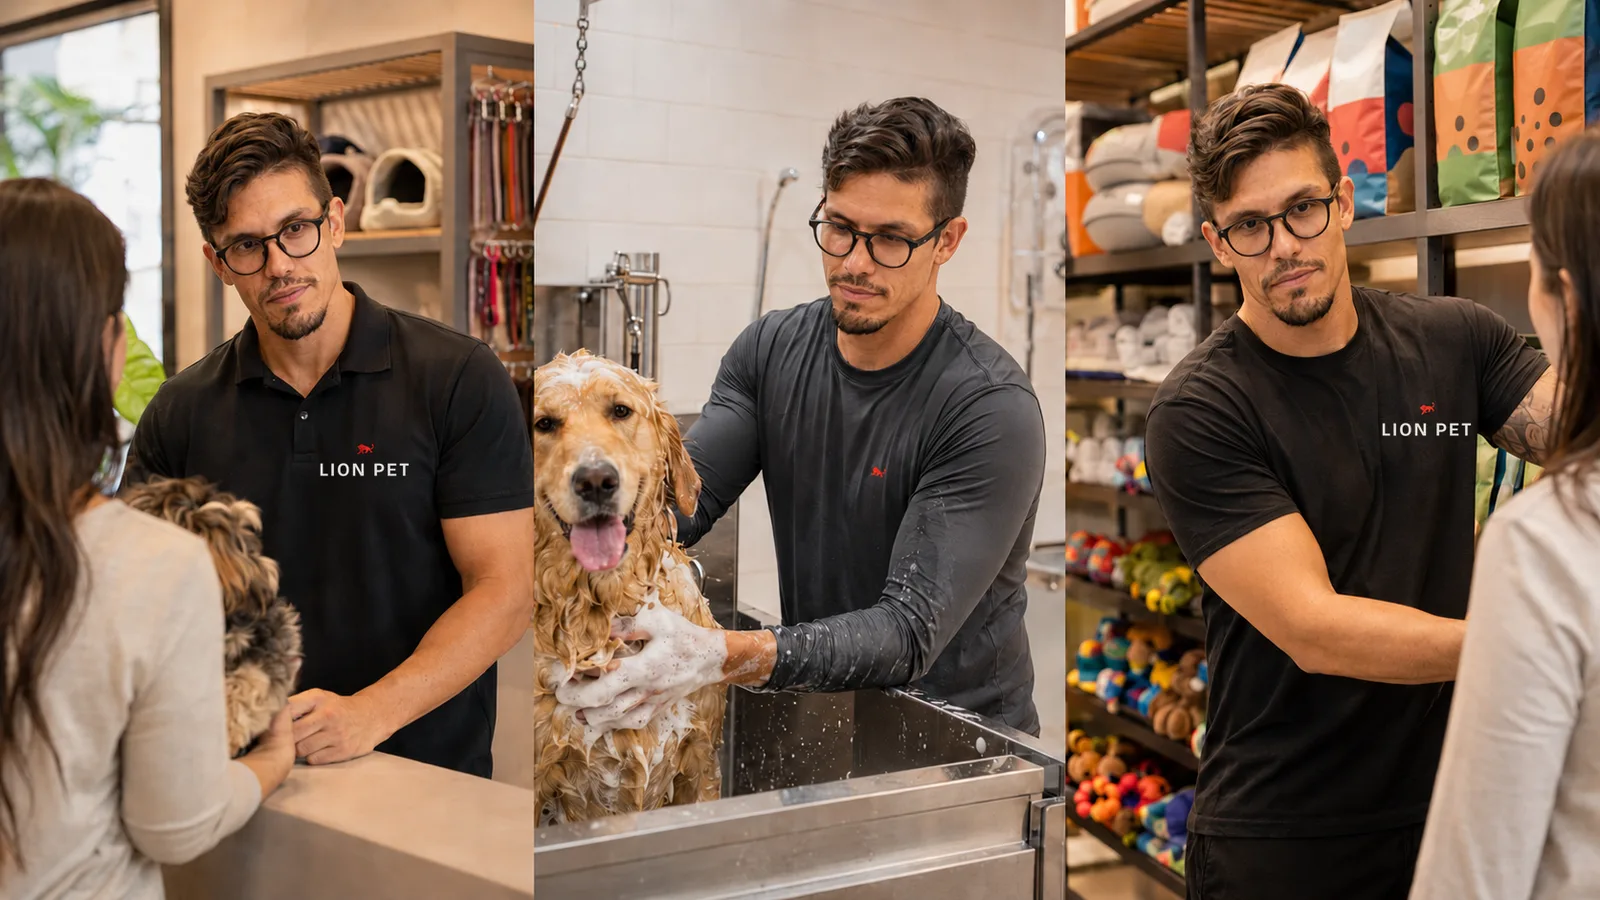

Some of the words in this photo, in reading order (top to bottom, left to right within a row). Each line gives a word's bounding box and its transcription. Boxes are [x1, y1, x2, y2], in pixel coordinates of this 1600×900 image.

[1382, 422, 1427, 437] LION
[1436, 422, 1472, 437] PET
[319, 462, 365, 477] LION
[373, 462, 410, 477] PET
